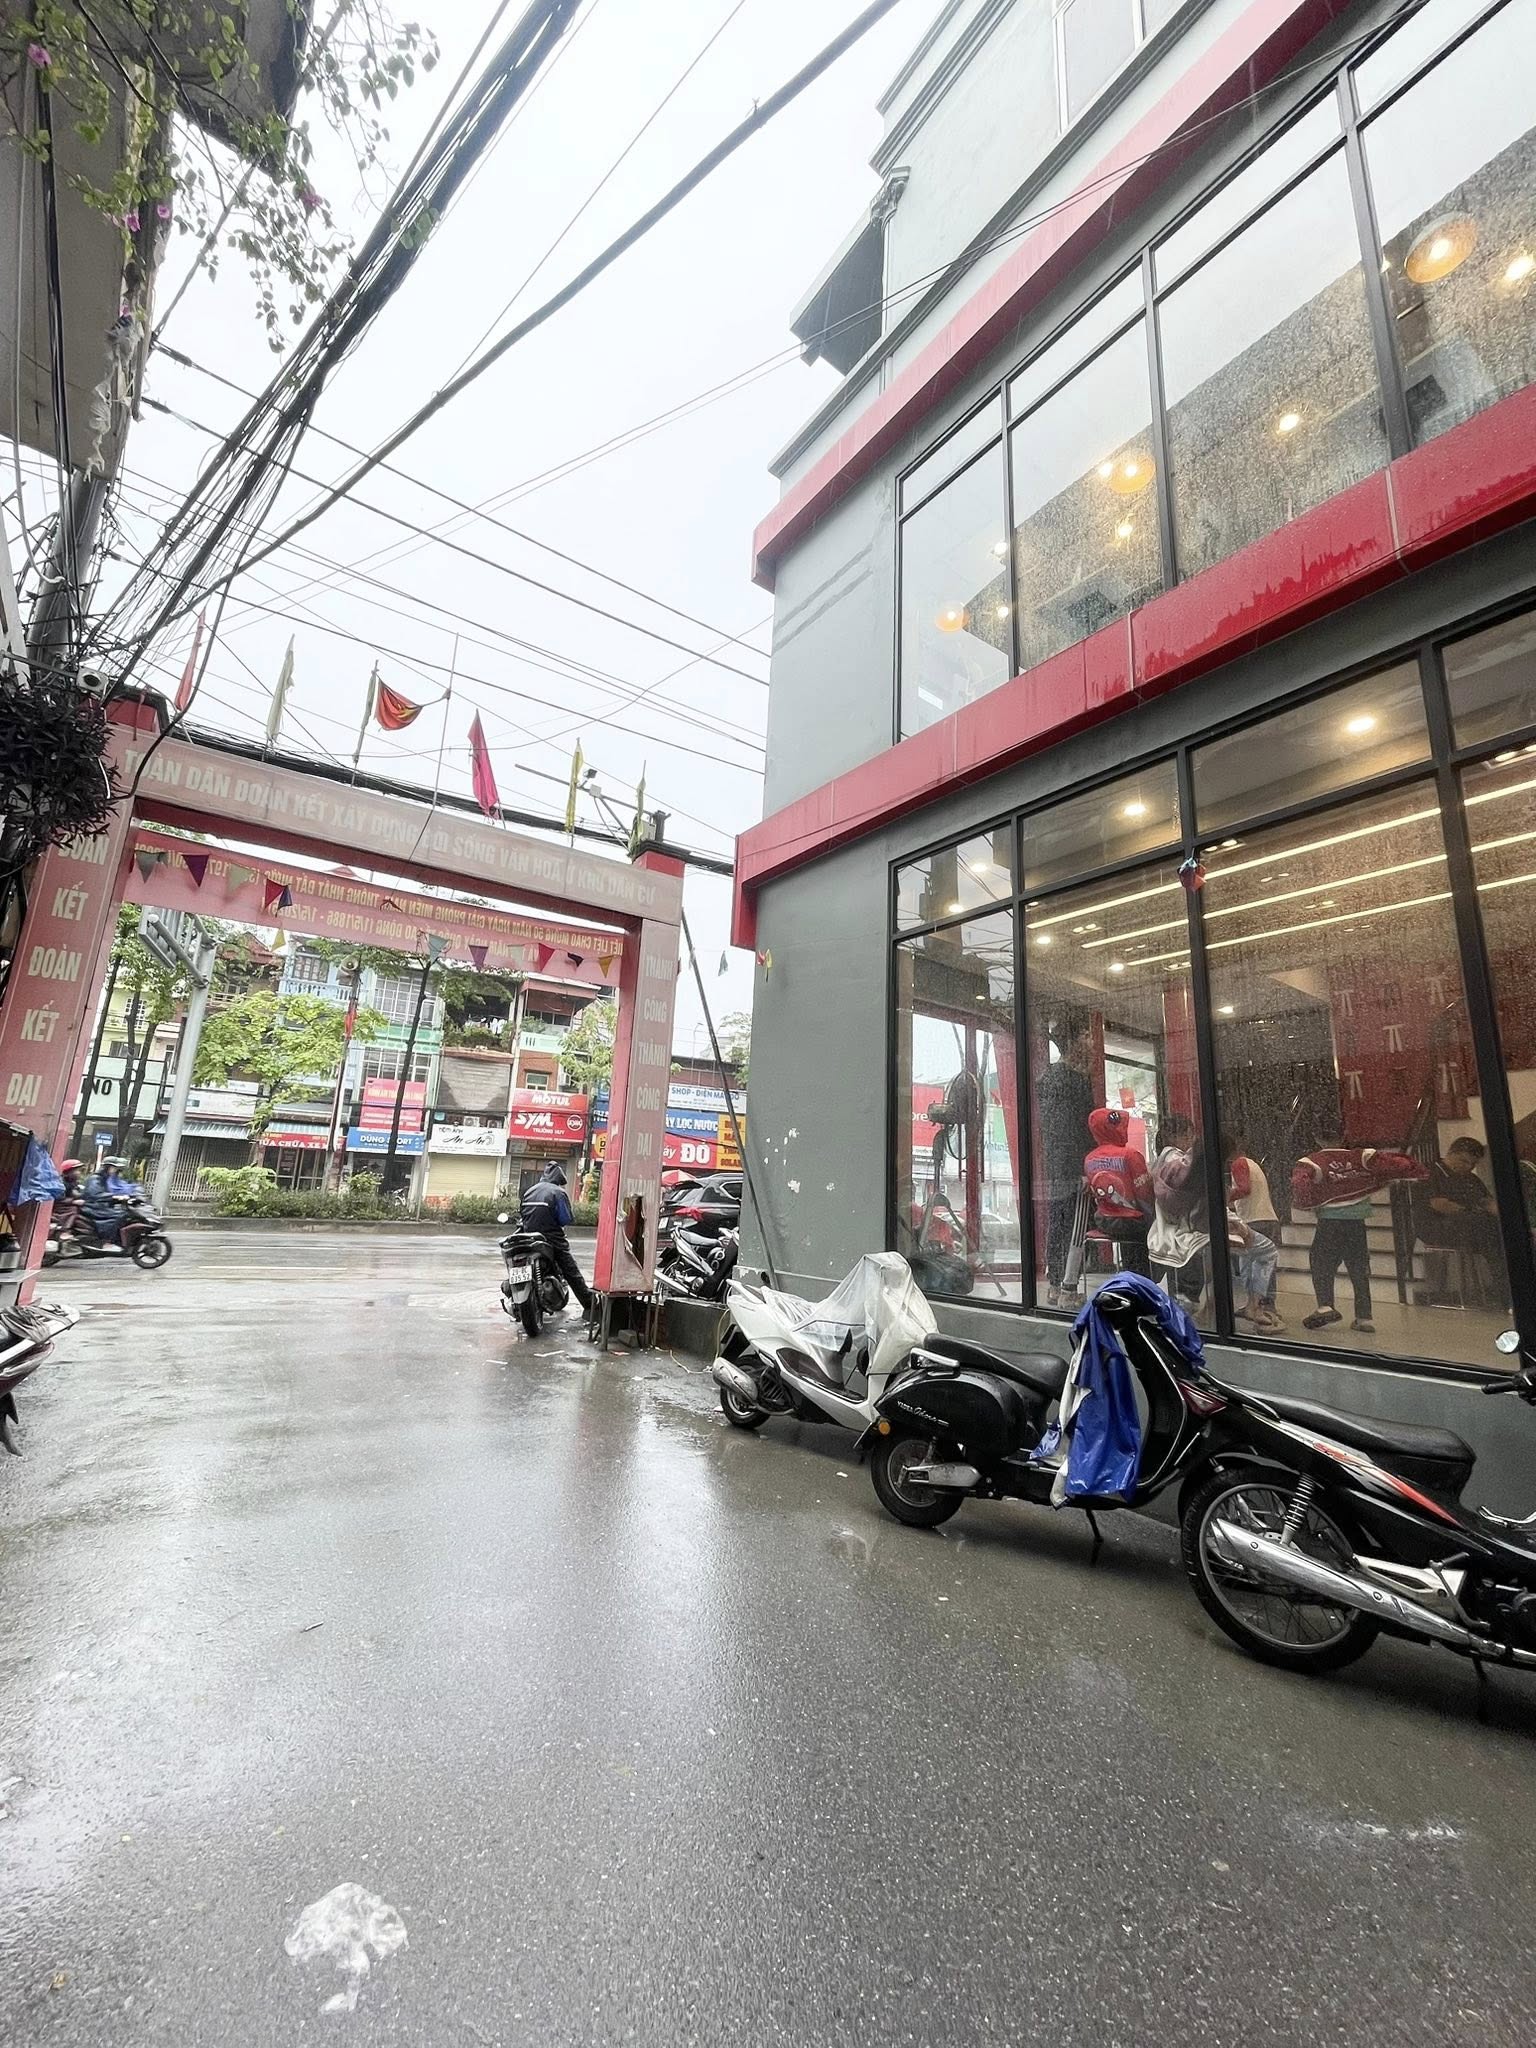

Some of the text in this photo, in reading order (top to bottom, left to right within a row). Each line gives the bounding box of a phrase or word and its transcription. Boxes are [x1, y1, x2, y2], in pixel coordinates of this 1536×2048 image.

[124, 749, 182, 785] TOÀN
[185, 765, 231, 798] DÂN
[234, 779, 289, 812] ĐOÀN
[293, 792, 329, 821] KẾT
[331, 803, 367, 832] XÂY
[453, 834, 495, 864] SỐNG
[500, 847, 529, 873] VĂN
[51, 880, 89, 921] KẾT
[27, 944, 82, 982] ĐOÀN
[20, 1000, 60, 1042] KẾT
[643, 995, 668, 1023] CÔNG
[638, 1038, 666, 1067] THÀNH
[5, 1072, 43, 1114] ĐẠI
[531, 1093, 570, 1106] MOTUL
[636, 1083, 660, 1111] CÔNG
[671, 1087, 691, 1096] SHOP
[514, 1110, 555, 1130] SYM
[678, 1117, 694, 1131] LỌC
[694, 1117, 718, 1132] NƯỚC
[386, 1136, 413, 1145] SORT
[636, 1132, 653, 1160] ĐẠI
